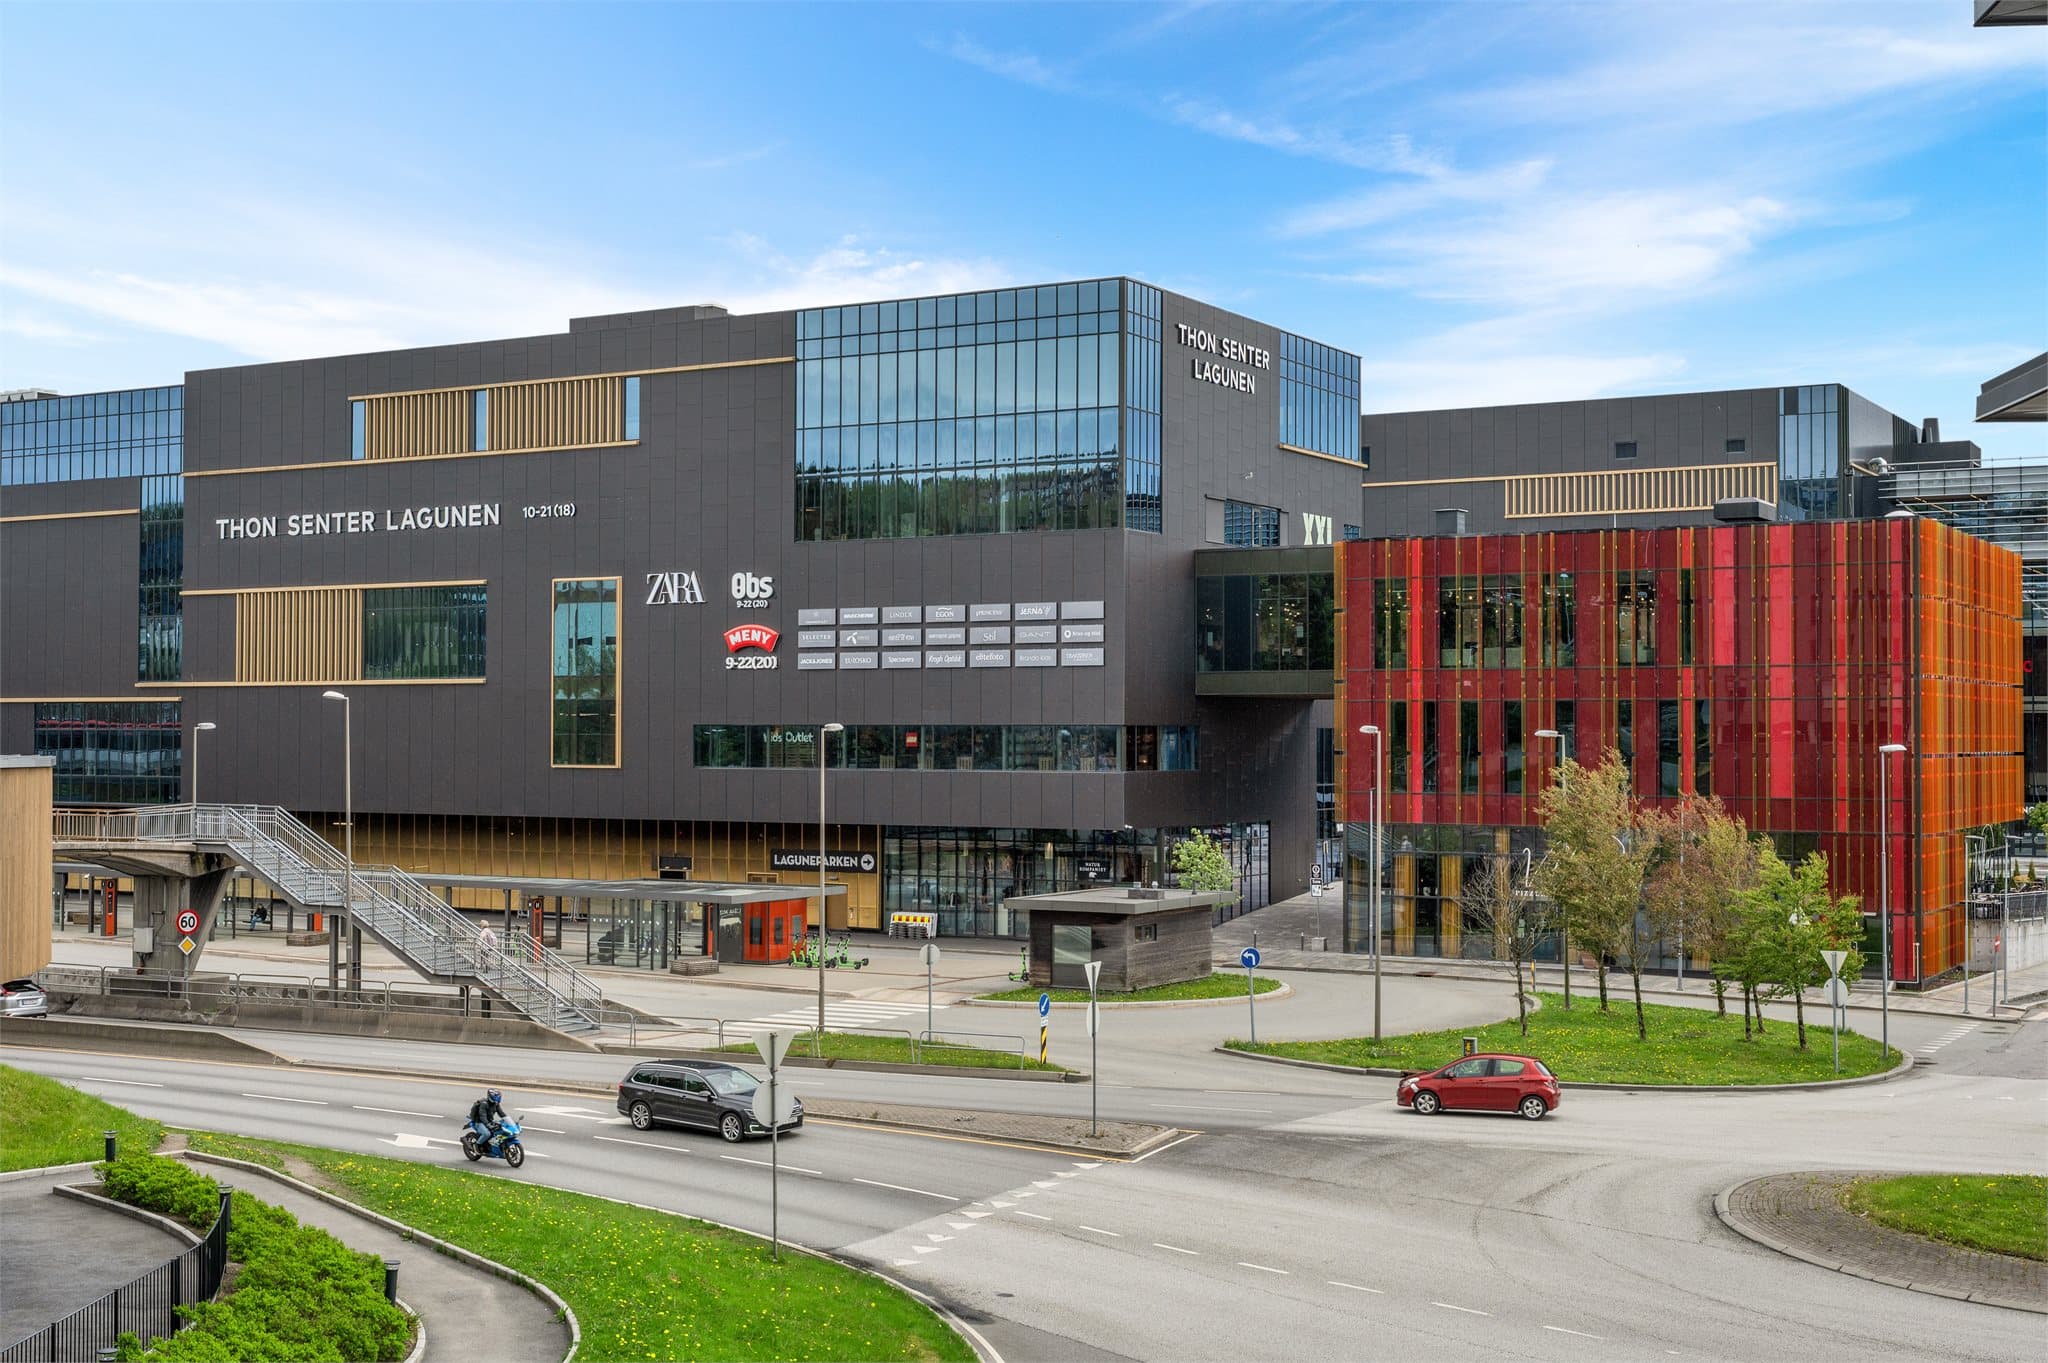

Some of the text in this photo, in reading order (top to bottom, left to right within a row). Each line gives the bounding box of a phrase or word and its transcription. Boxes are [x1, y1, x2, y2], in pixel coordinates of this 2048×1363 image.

[1179, 323, 1270, 370] THON SENTER
[1195, 358, 1255, 394] LAGUNEN
[216, 503, 500, 540] THON SENTER LAGUNEN
[646, 570, 706, 605] ZARA
[728, 629, 771, 646] MENY
[785, 731, 814, 743] Outlet
[774, 854, 858, 868] LAGUNEPARKEN
[180, 915, 196, 929] 60
